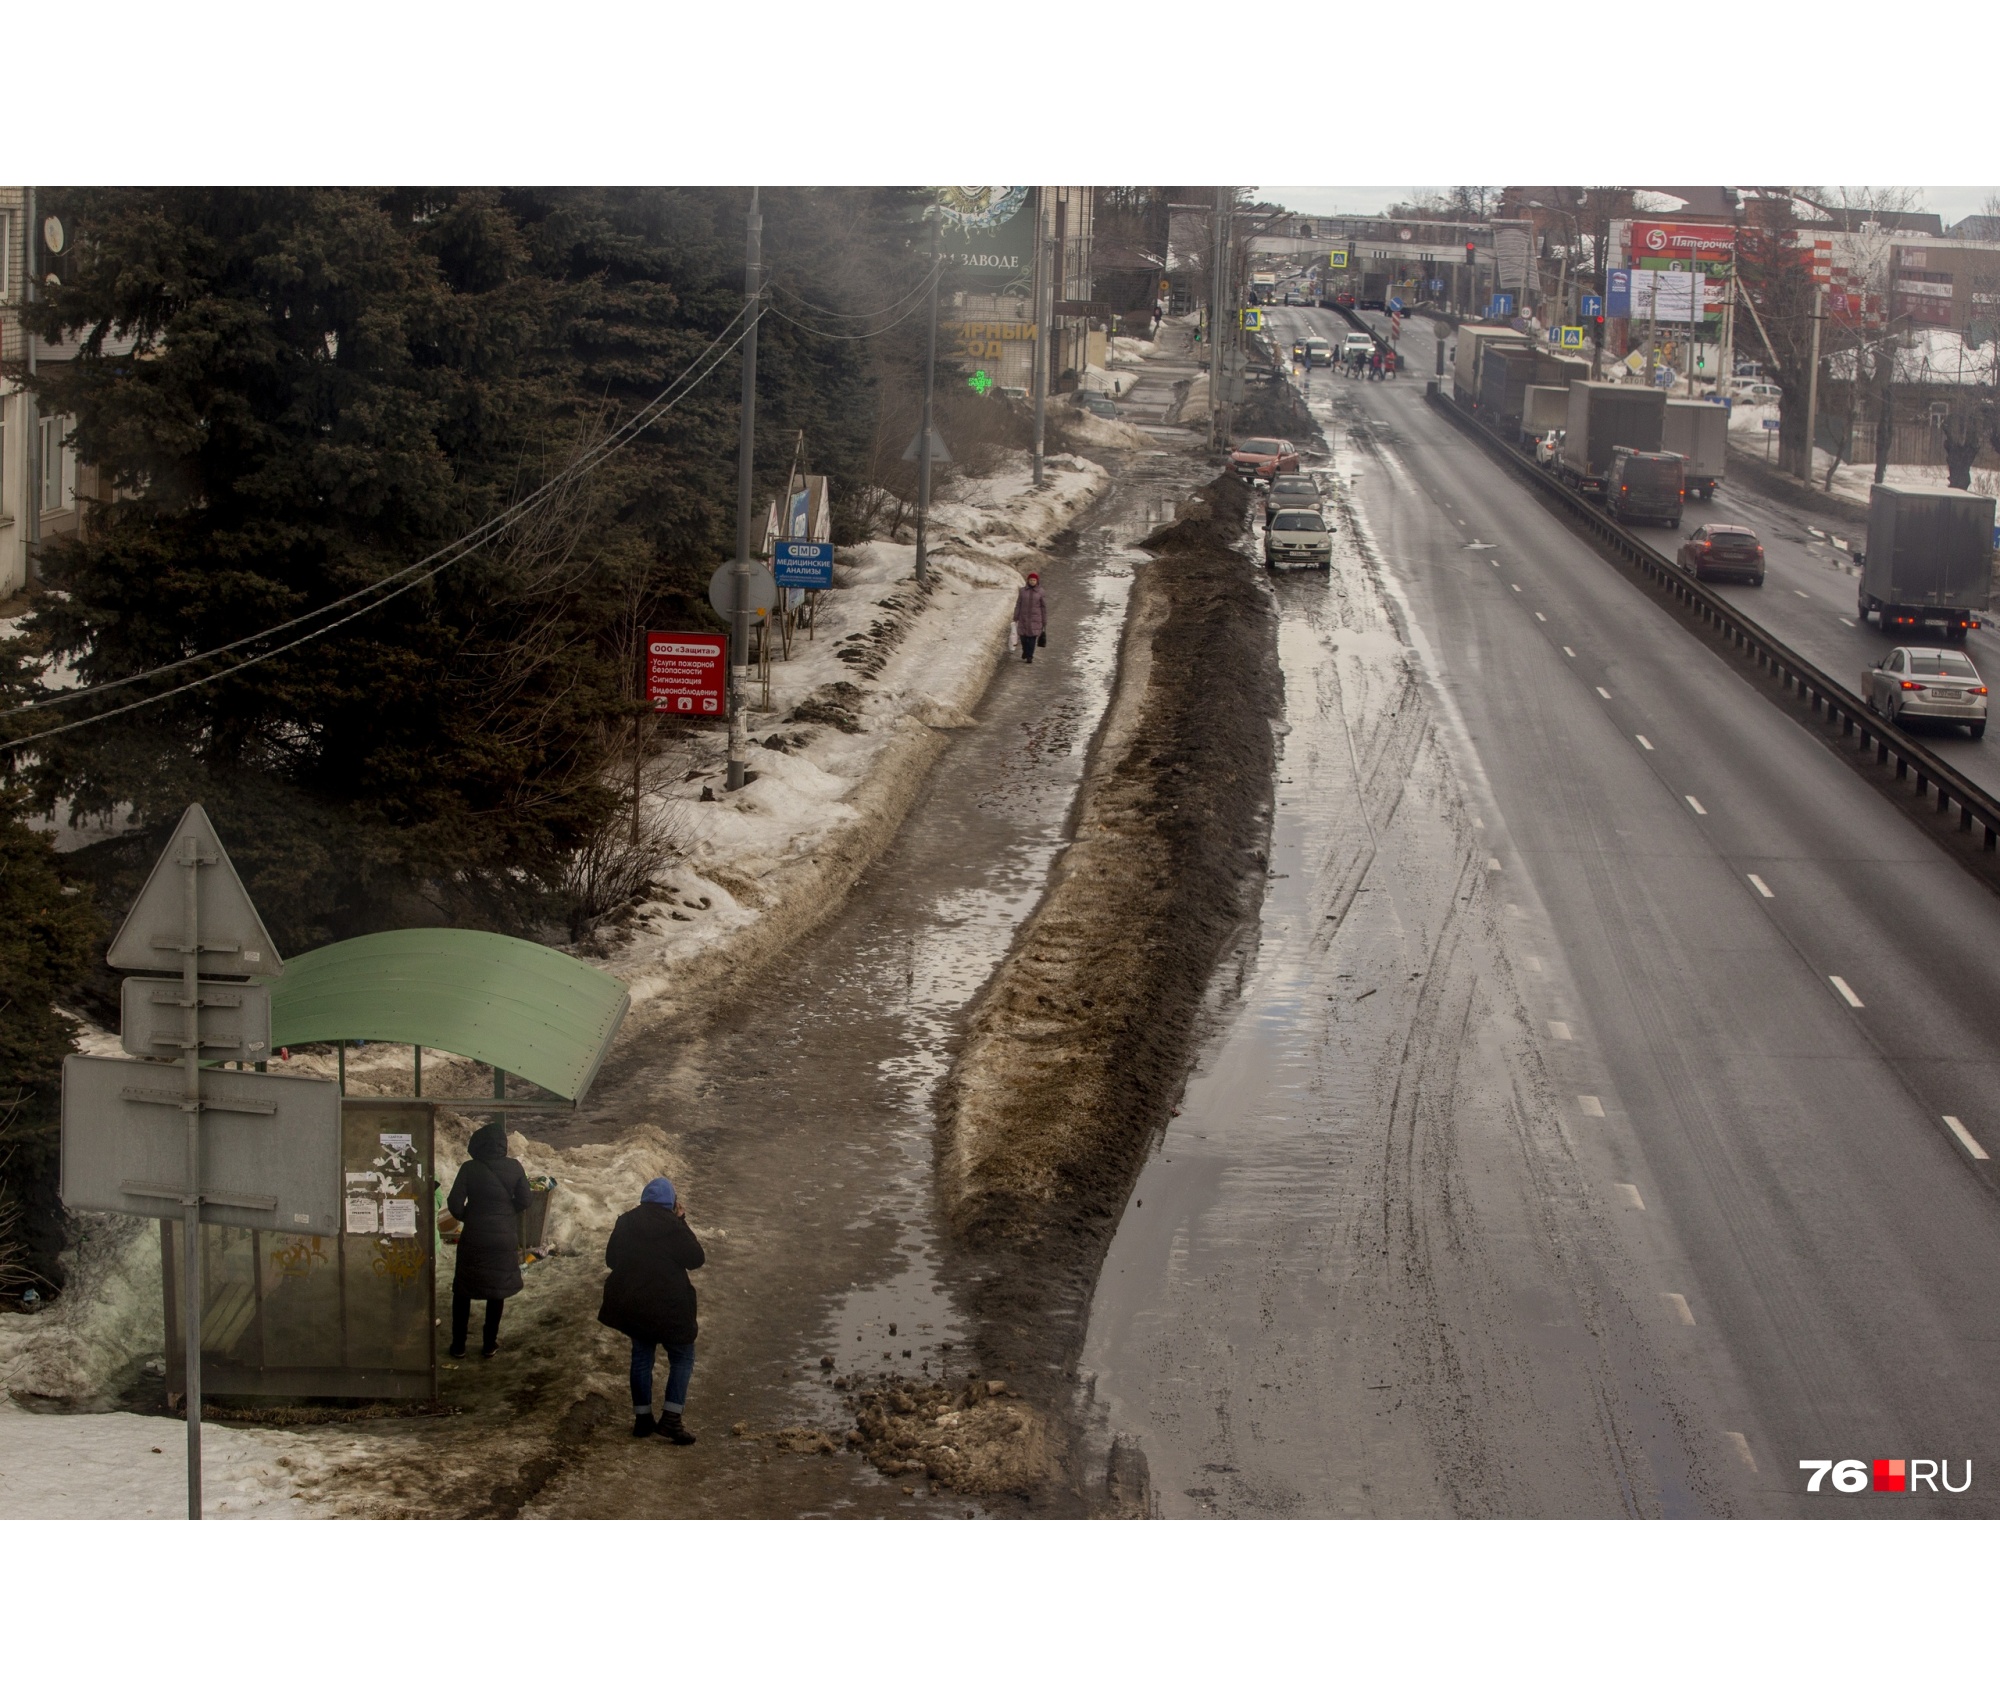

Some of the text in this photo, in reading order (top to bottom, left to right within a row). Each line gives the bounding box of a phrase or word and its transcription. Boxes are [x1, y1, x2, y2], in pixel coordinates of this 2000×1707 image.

[961, 253, 1019, 270] ЗАВОДЕ
[789, 546, 819, 556] CMD
[776, 558, 831, 567] МЕДИЦИНСКИЕ
[785, 567, 821, 575] АНАЛИЗЫ
[675, 646, 715, 655] «Защита»
[678, 660, 715, 669] пожарной
[652, 665, 703, 675] безопасности
